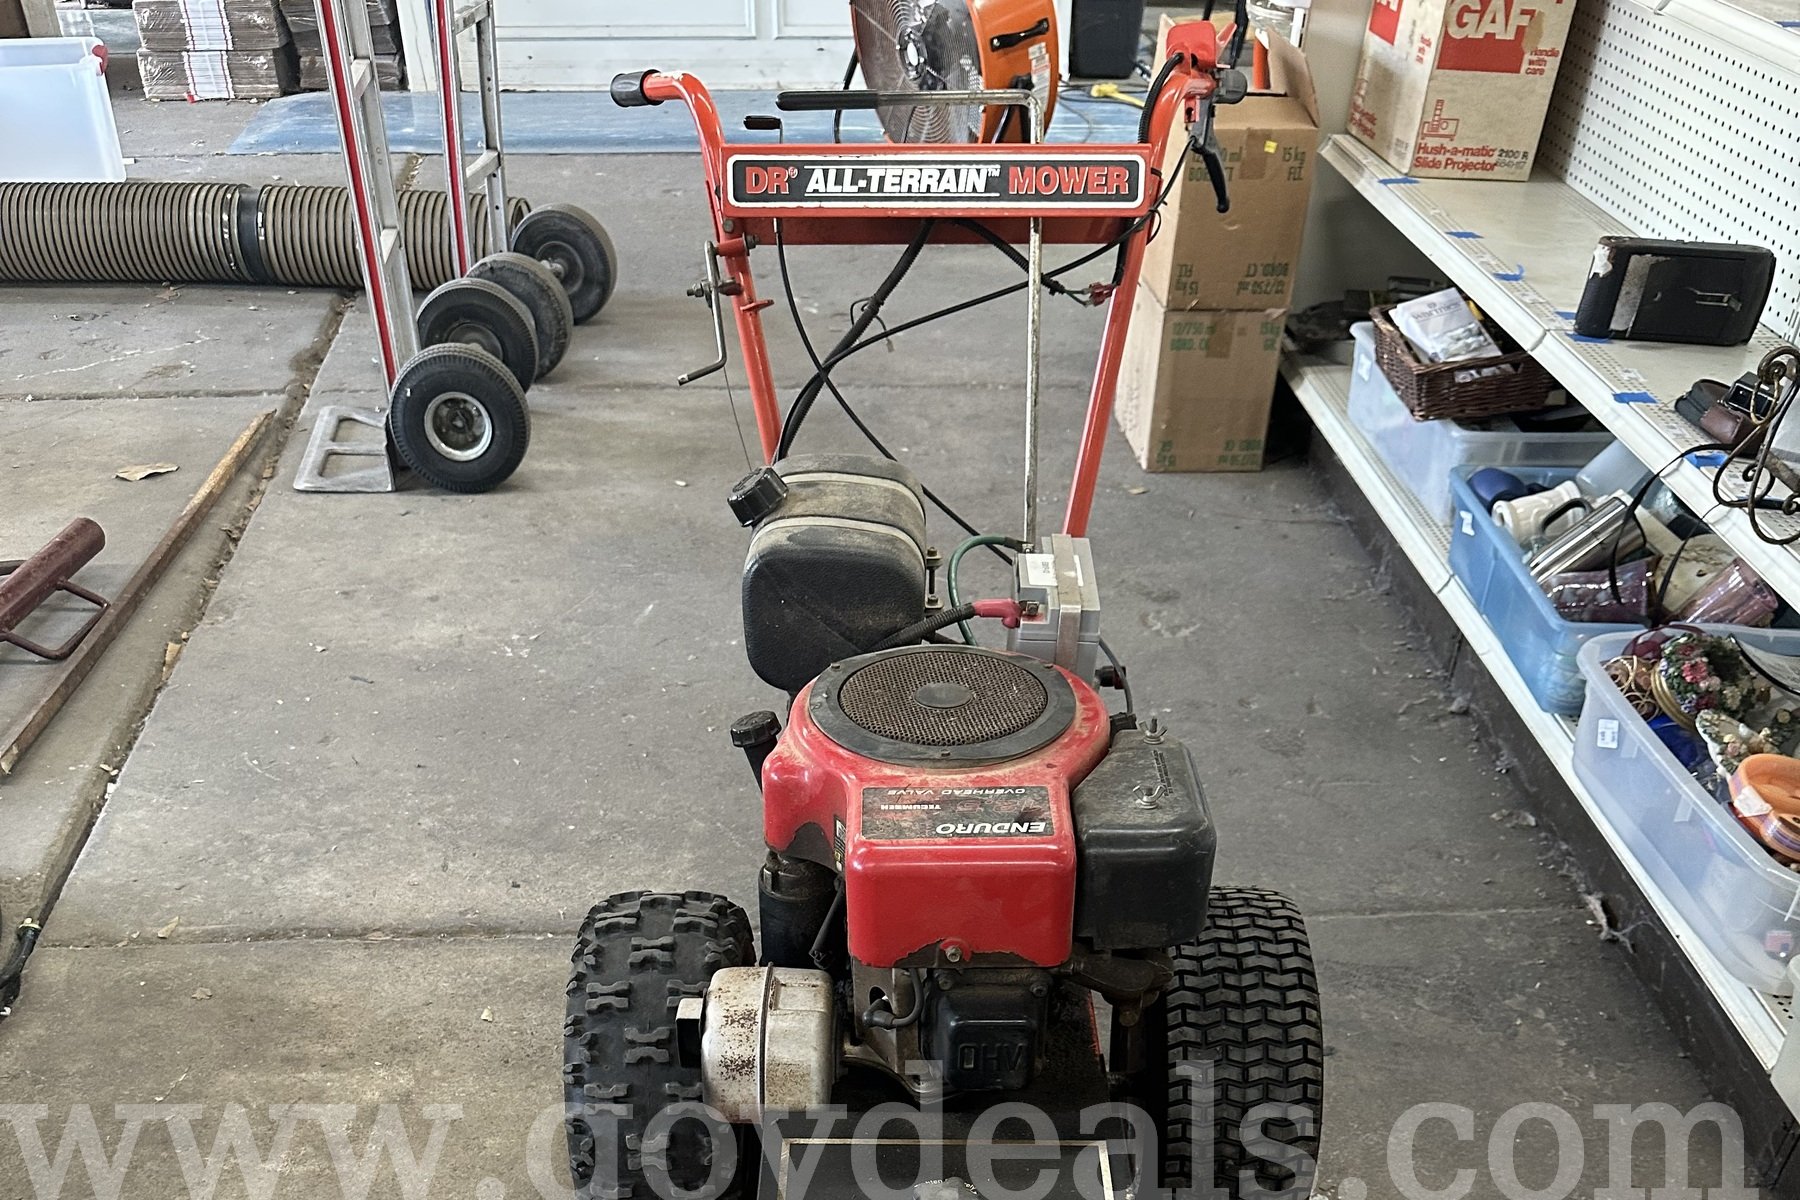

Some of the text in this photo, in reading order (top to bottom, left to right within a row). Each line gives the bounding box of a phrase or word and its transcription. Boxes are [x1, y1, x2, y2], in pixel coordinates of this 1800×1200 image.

[1446, 0, 1538, 40] GAF
[1528, 57, 1547, 67] with
[1525, 67, 1545, 75] care
[1417, 143, 1496, 158] Hush-a-matic
[1414, 156, 1441, 169] Slide
[1444, 158, 1497, 172] Projector
[1008, 165, 1129, 195] MOWER
[935, 822, 1047, 835] ENDURO
[958, 1042, 1028, 1073] OHV
